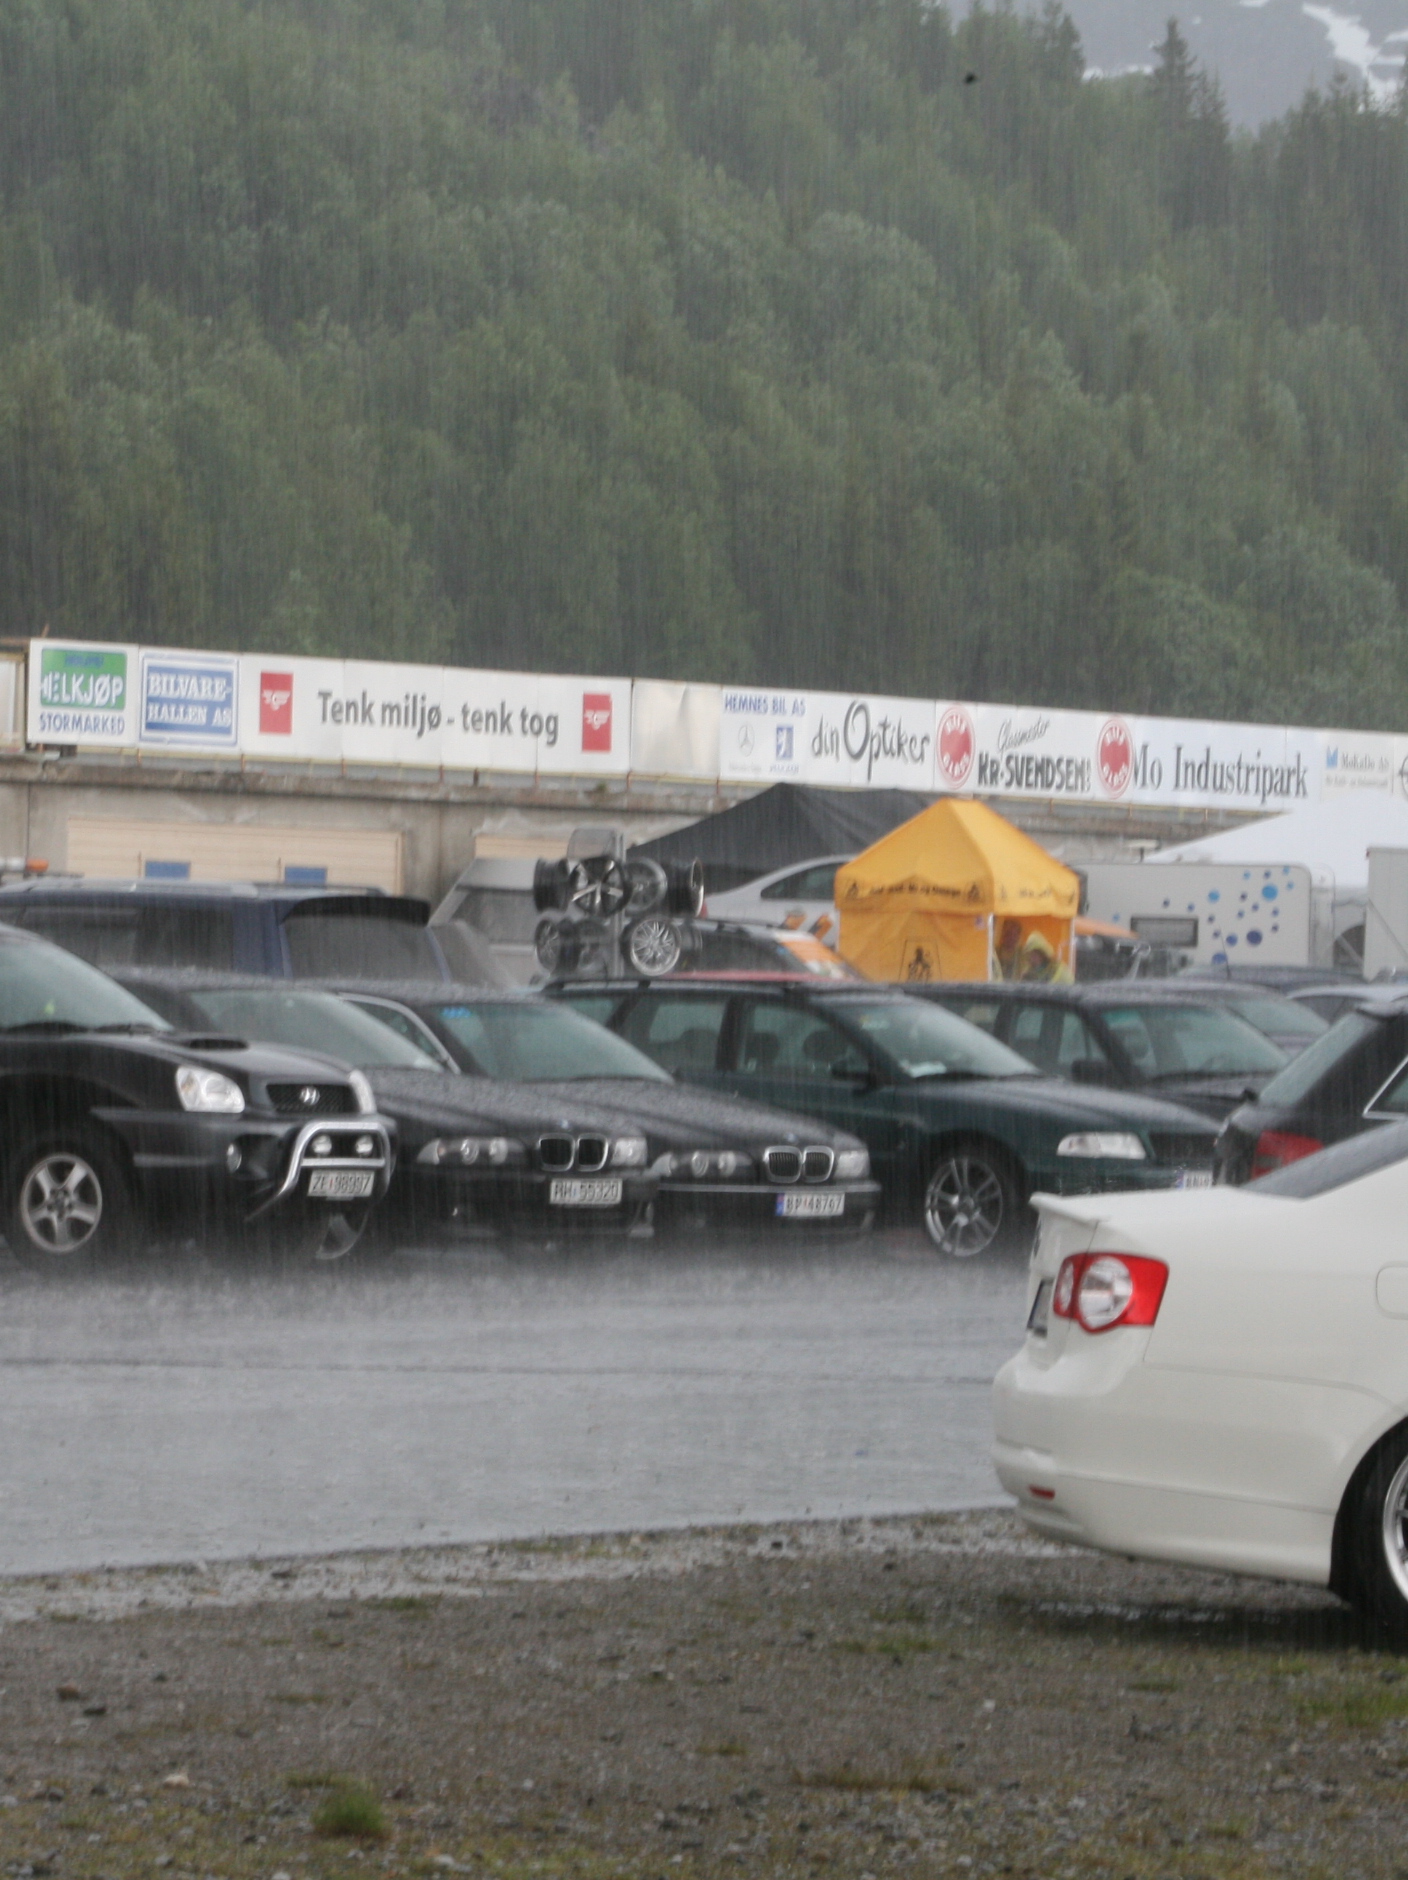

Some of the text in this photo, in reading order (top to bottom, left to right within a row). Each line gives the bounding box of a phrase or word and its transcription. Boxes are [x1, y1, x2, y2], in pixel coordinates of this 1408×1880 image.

[40, 712, 126, 735] STORMARKED
[147, 703, 232, 728] HALLEN AS
[318, 690, 375, 725] Tenk
[381, 692, 442, 738] miljø
[461, 700, 513, 735] tenk
[520, 705, 560, 746] tog
[724, 693, 806, 717] HEMNES BIL AS
[811, 700, 930, 783] din Optiker
[1173, 744, 1309, 806] Industripark
